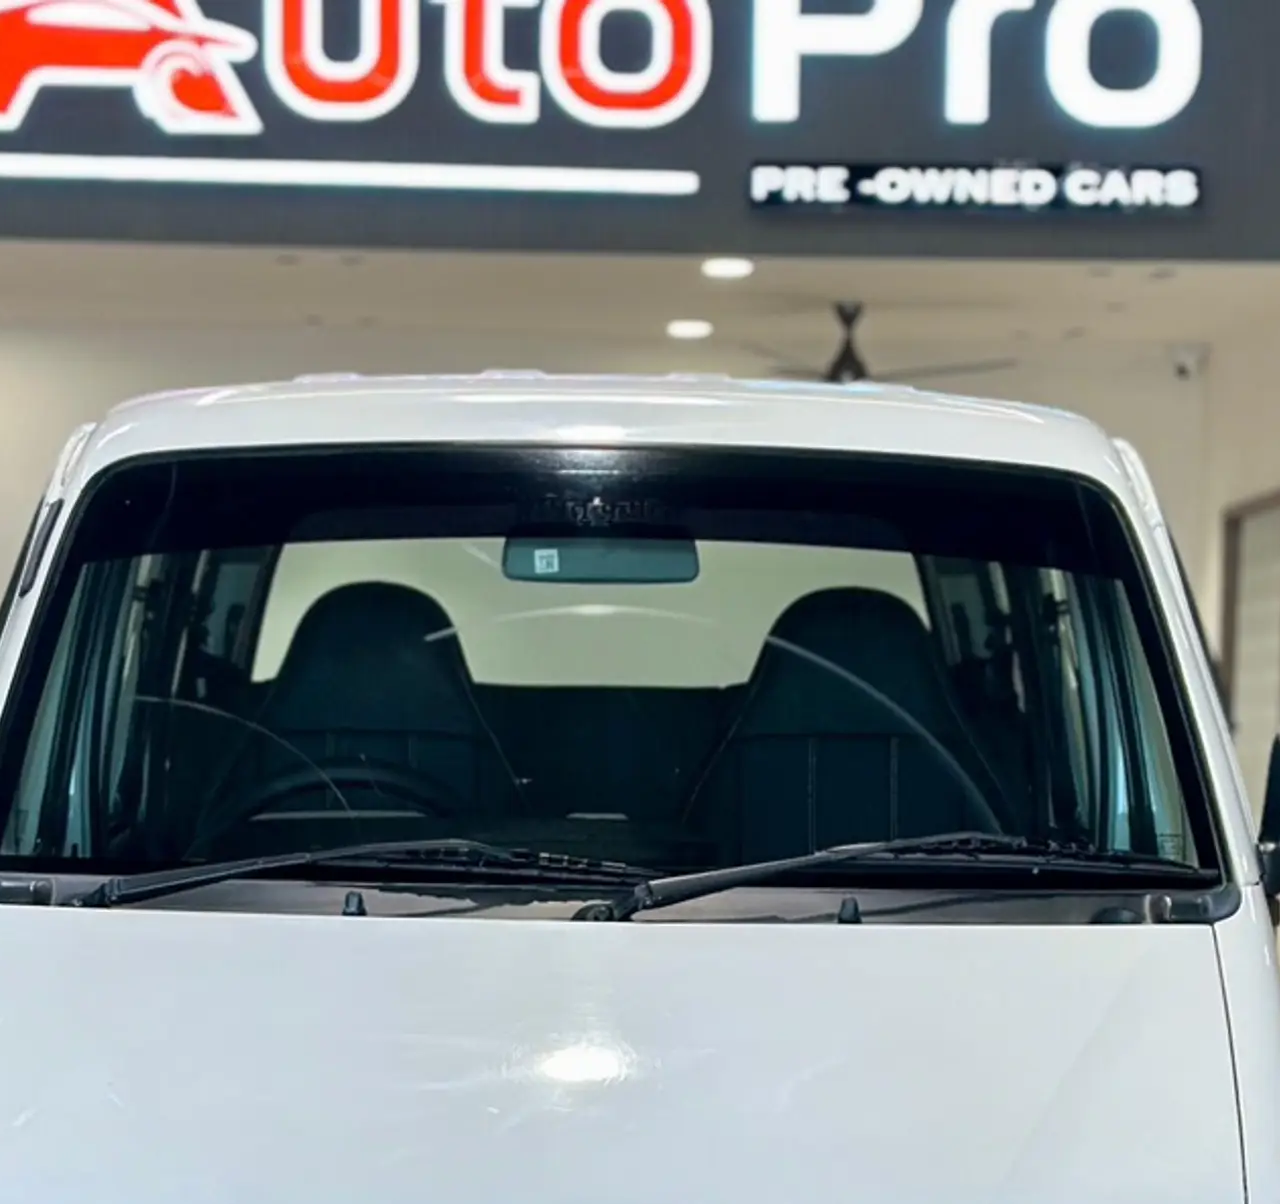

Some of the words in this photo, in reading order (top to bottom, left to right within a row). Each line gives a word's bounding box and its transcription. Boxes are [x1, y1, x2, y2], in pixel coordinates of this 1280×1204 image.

[751, 0, 1201, 127] Pro
[751, 166, 850, 202] PRE
[1064, 169, 1199, 206] CARS
